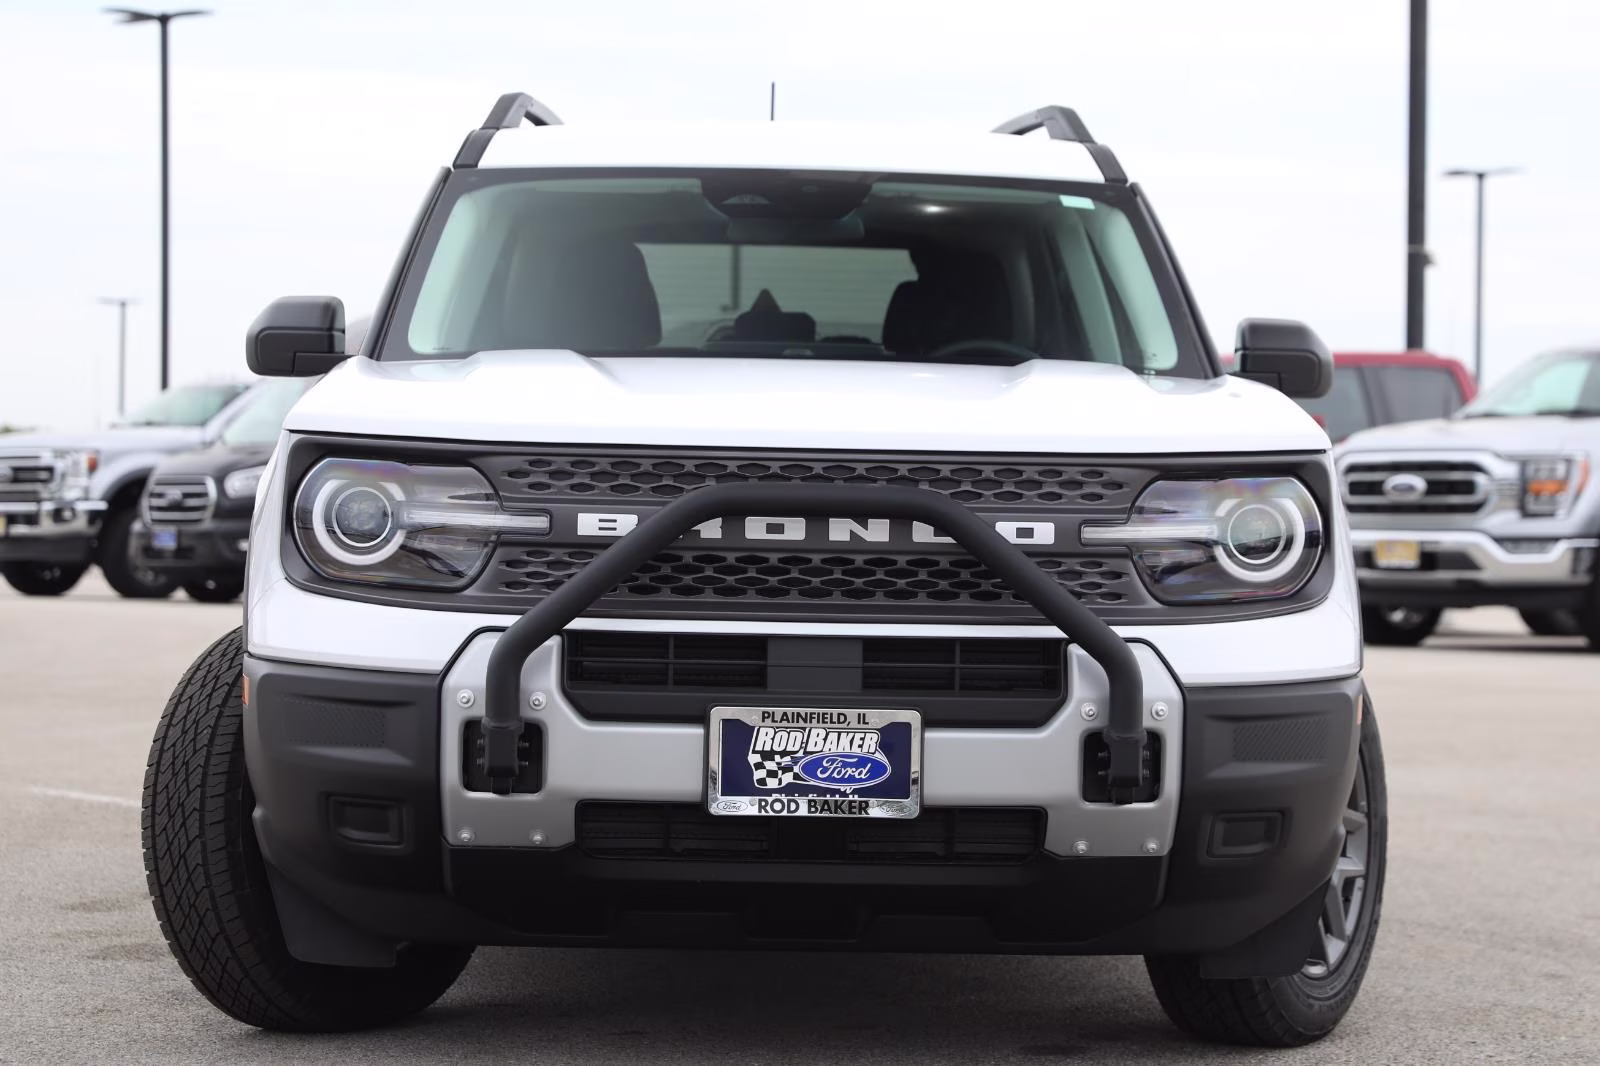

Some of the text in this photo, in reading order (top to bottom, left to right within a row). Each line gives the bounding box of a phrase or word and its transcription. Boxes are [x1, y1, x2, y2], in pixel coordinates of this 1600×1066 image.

[761, 711, 870, 726] PLAINFIELD, IL
[754, 727, 880, 754] ROD BAKER
[816, 756, 871, 780] Ford
[757, 798, 871, 816] ROD BAKER
